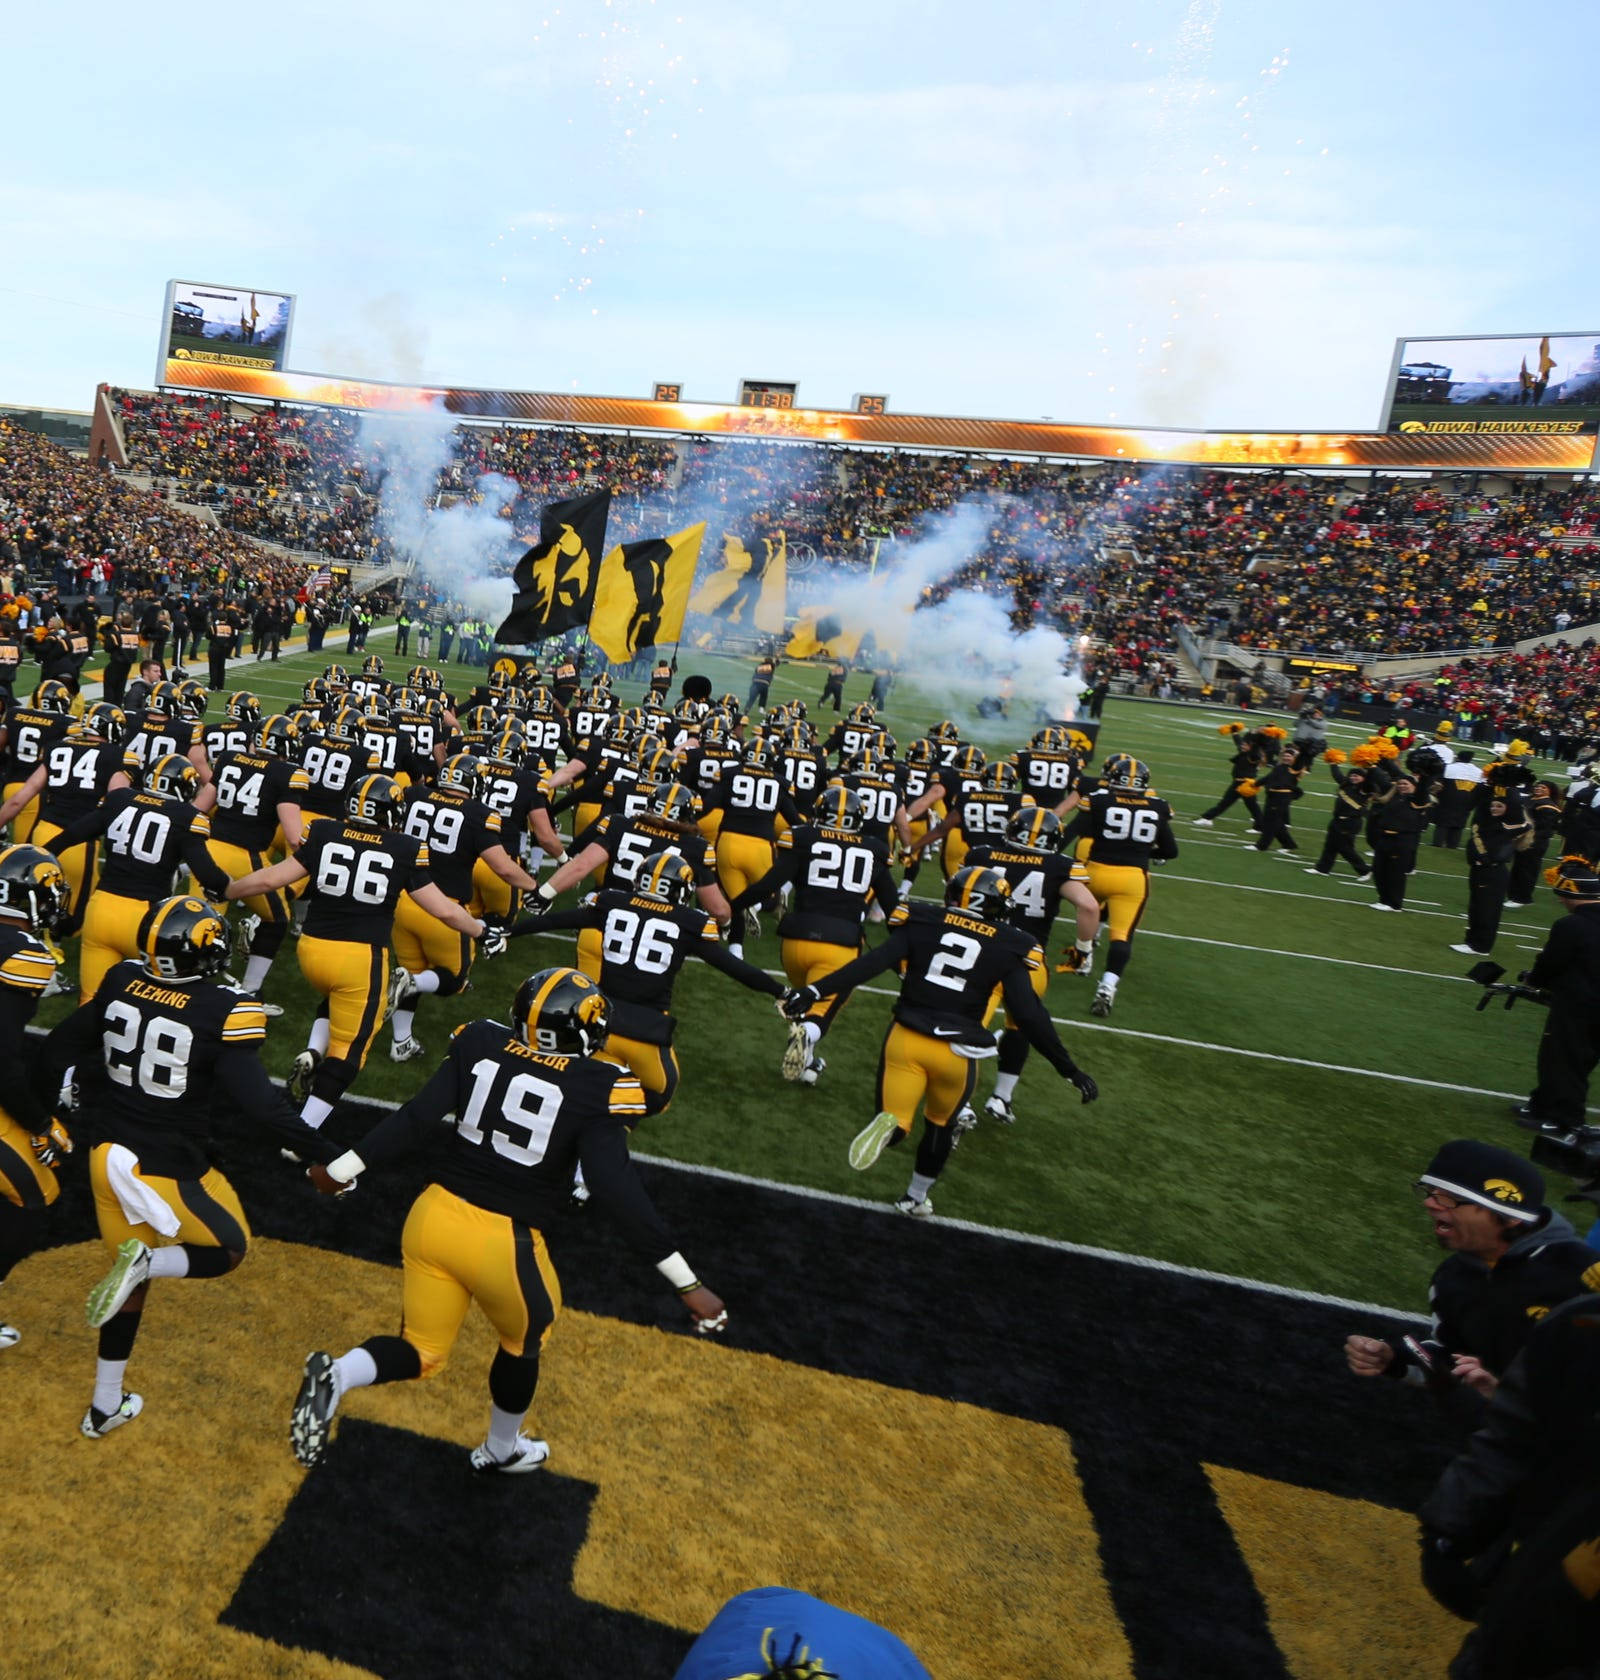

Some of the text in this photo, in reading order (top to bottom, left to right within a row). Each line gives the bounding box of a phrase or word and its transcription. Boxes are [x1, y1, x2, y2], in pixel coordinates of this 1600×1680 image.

[657, 385, 679, 402] 25
[749, 391, 794, 409] 11:38
[861, 397, 884, 414] 25
[1426, 421, 1584, 434] IOWA HAWKEYES
[41, 699, 50, 709] 6
[13, 712, 54, 727] SPEARMAN
[142, 721, 166, 733] WARD
[330, 724, 349, 736] 88
[576, 712, 611, 736] 87
[17, 726, 42, 763] 6
[206, 730, 247, 764] 26
[525, 719, 561, 750] 92
[47, 746, 101, 790] 94
[232, 753, 269, 769] CROSTON
[302, 746, 352, 791] 88
[784, 757, 818, 790] 16
[145, 773, 169, 792] 40
[440, 767, 464, 784] 69
[1029, 759, 1070, 790] 98
[216, 765, 266, 816] 64
[731, 774, 780, 812] 90
[349, 798, 377, 818] 66
[653, 801, 680, 819] 54
[857, 786, 897, 824] 30
[963, 801, 1010, 834] 85
[404, 800, 465, 855] 69
[633, 821, 680, 842] FERENTZ
[825, 813, 854, 828] 20
[1102, 806, 1160, 844] 96
[106, 806, 172, 865] 40
[342, 828, 383, 846] GOEDEL
[820, 829, 863, 845] OUTSEY
[1017, 830, 1049, 848] 44
[807, 841, 875, 895] 20
[989, 850, 1045, 866] NIEMANN
[316, 841, 395, 905] 66
[639, 873, 672, 896] 86
[629, 896, 674, 914] BISHOP
[968, 891, 986, 912] 2
[943, 912, 997, 938] RUCKER
[603, 907, 681, 975] 86
[923, 931, 982, 993] 2
[124, 978, 192, 1011] FLEMING
[102, 999, 195, 1099] 28
[521, 1021, 558, 1051] 19
[503, 1038, 571, 1072] TAYLOR
[456, 1057, 565, 1168] 19
